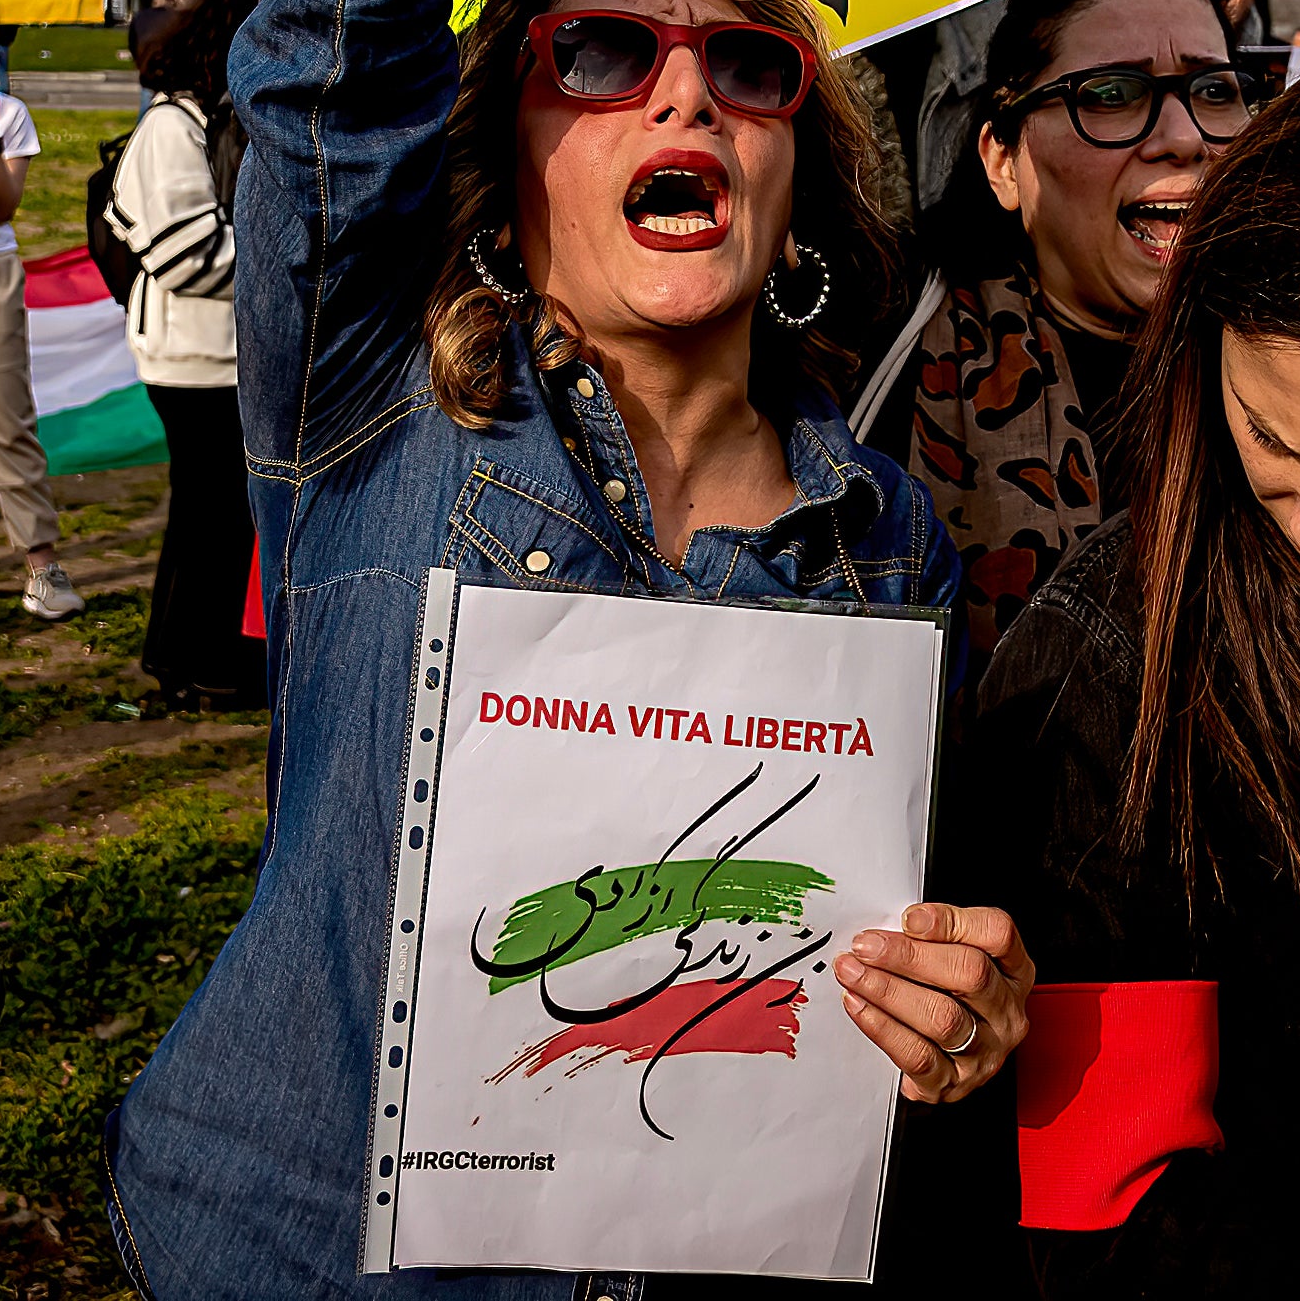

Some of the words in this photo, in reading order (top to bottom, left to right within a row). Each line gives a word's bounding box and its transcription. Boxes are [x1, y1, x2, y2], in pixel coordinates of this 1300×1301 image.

[479, 691, 616, 736] DONNA
[627, 705, 712, 744] VITA
[724, 714, 875, 757] LIBERTÀ
[401, 1151, 556, 1171] #IRGCterrorist
